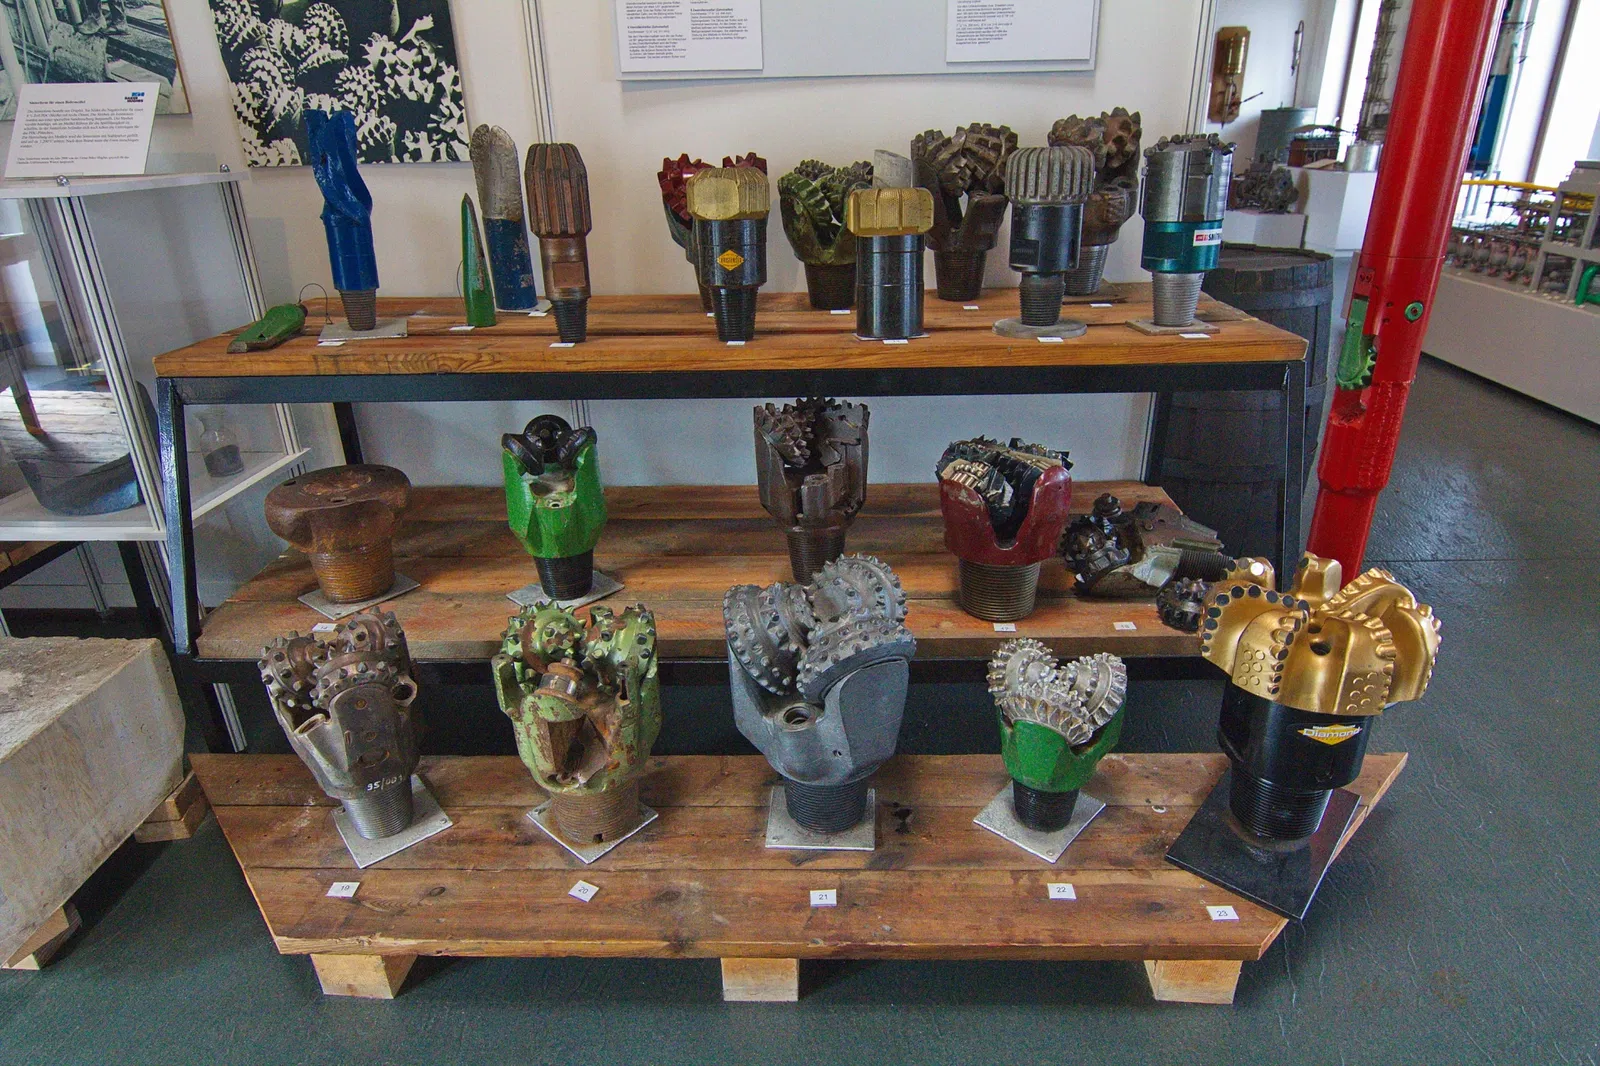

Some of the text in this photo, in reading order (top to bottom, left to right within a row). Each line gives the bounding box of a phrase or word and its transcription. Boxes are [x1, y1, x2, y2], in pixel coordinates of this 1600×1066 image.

[1303, 726, 1361, 738] Diamond
[578, 886, 589, 894] 20
[1216, 909, 1228, 917] 23
